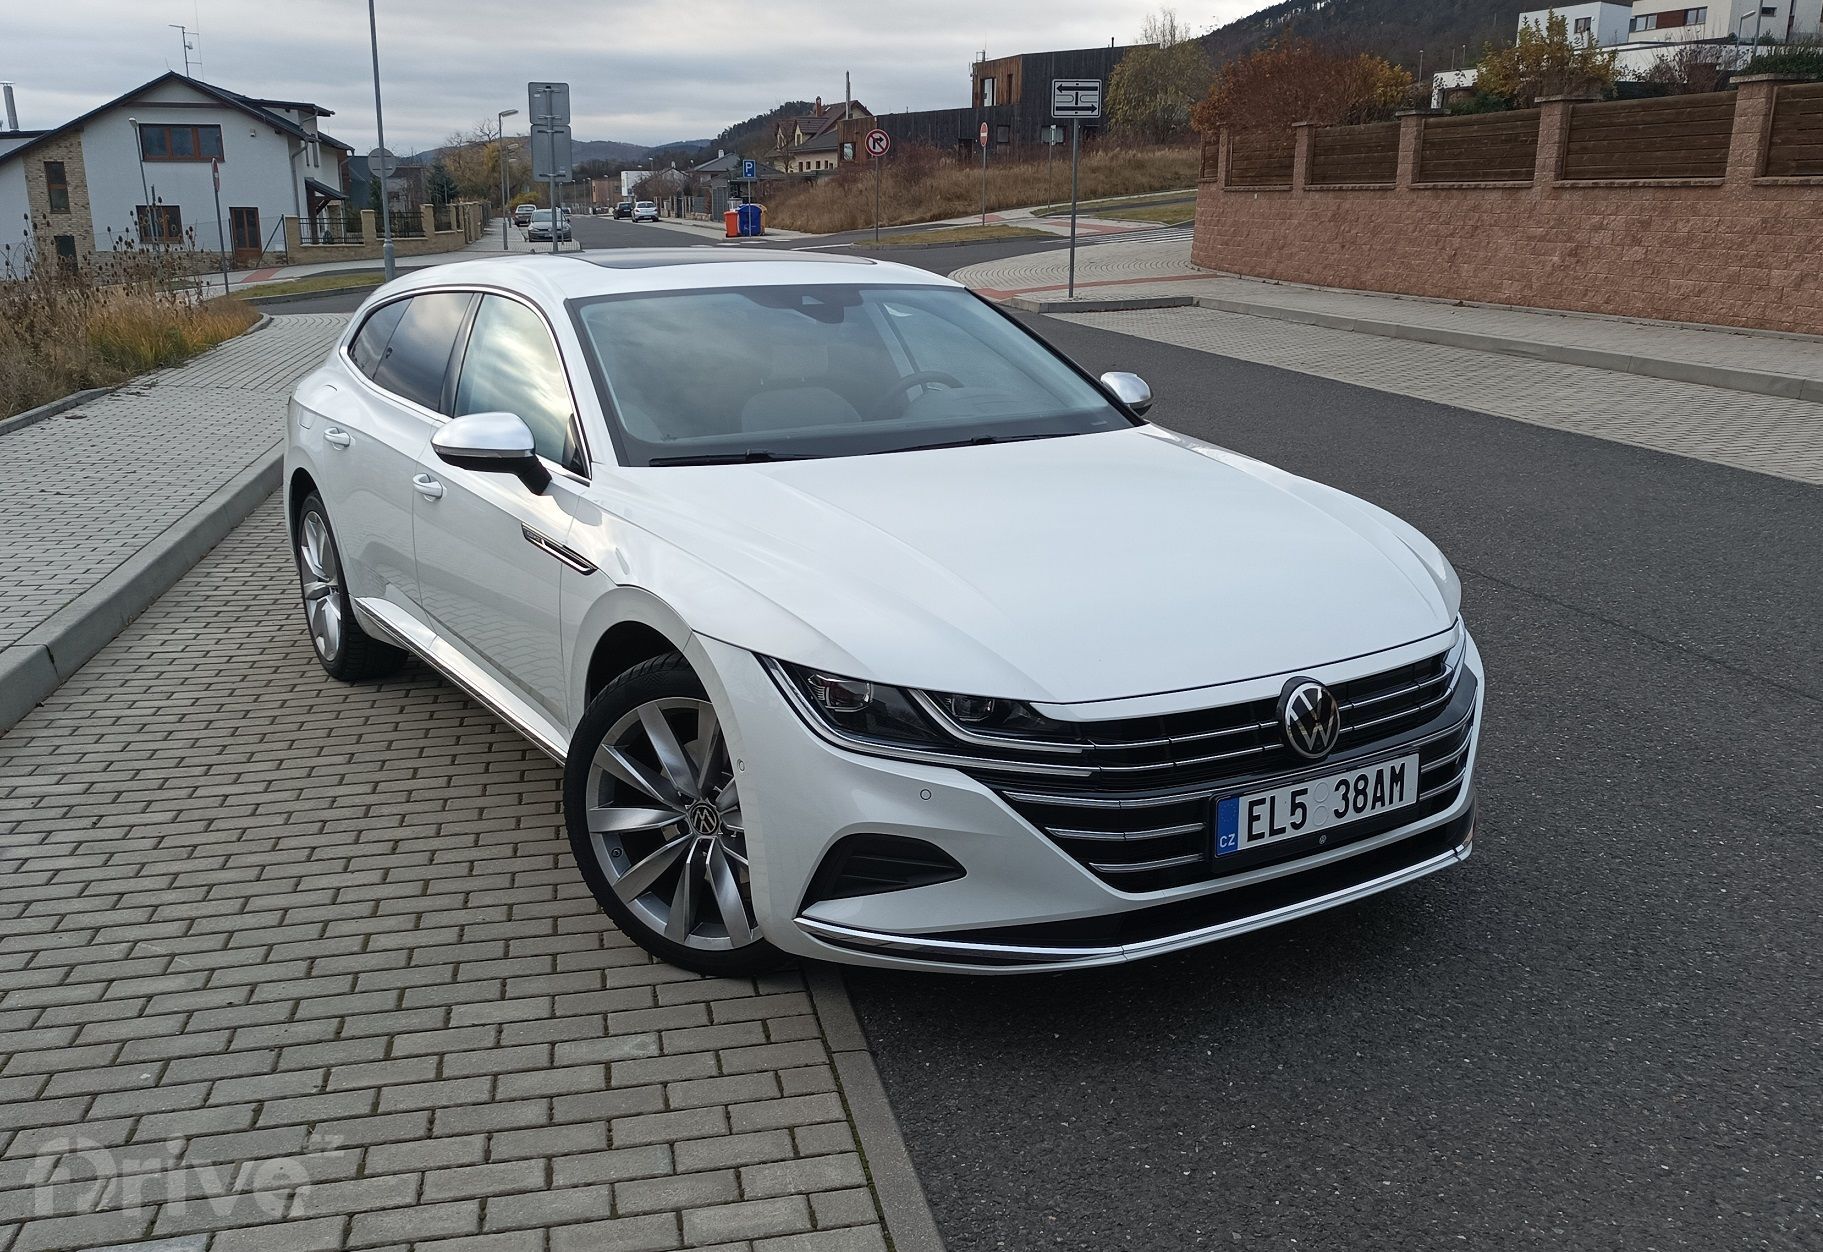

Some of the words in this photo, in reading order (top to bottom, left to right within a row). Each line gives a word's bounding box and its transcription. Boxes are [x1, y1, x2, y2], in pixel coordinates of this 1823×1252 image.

[745, 162, 753, 173] P
[1285, 682, 1340, 758] VW
[1246, 788, 1309, 843] EL5
[1333, 762, 1406, 819] 38AM
[1219, 834, 1236, 848] CZ
